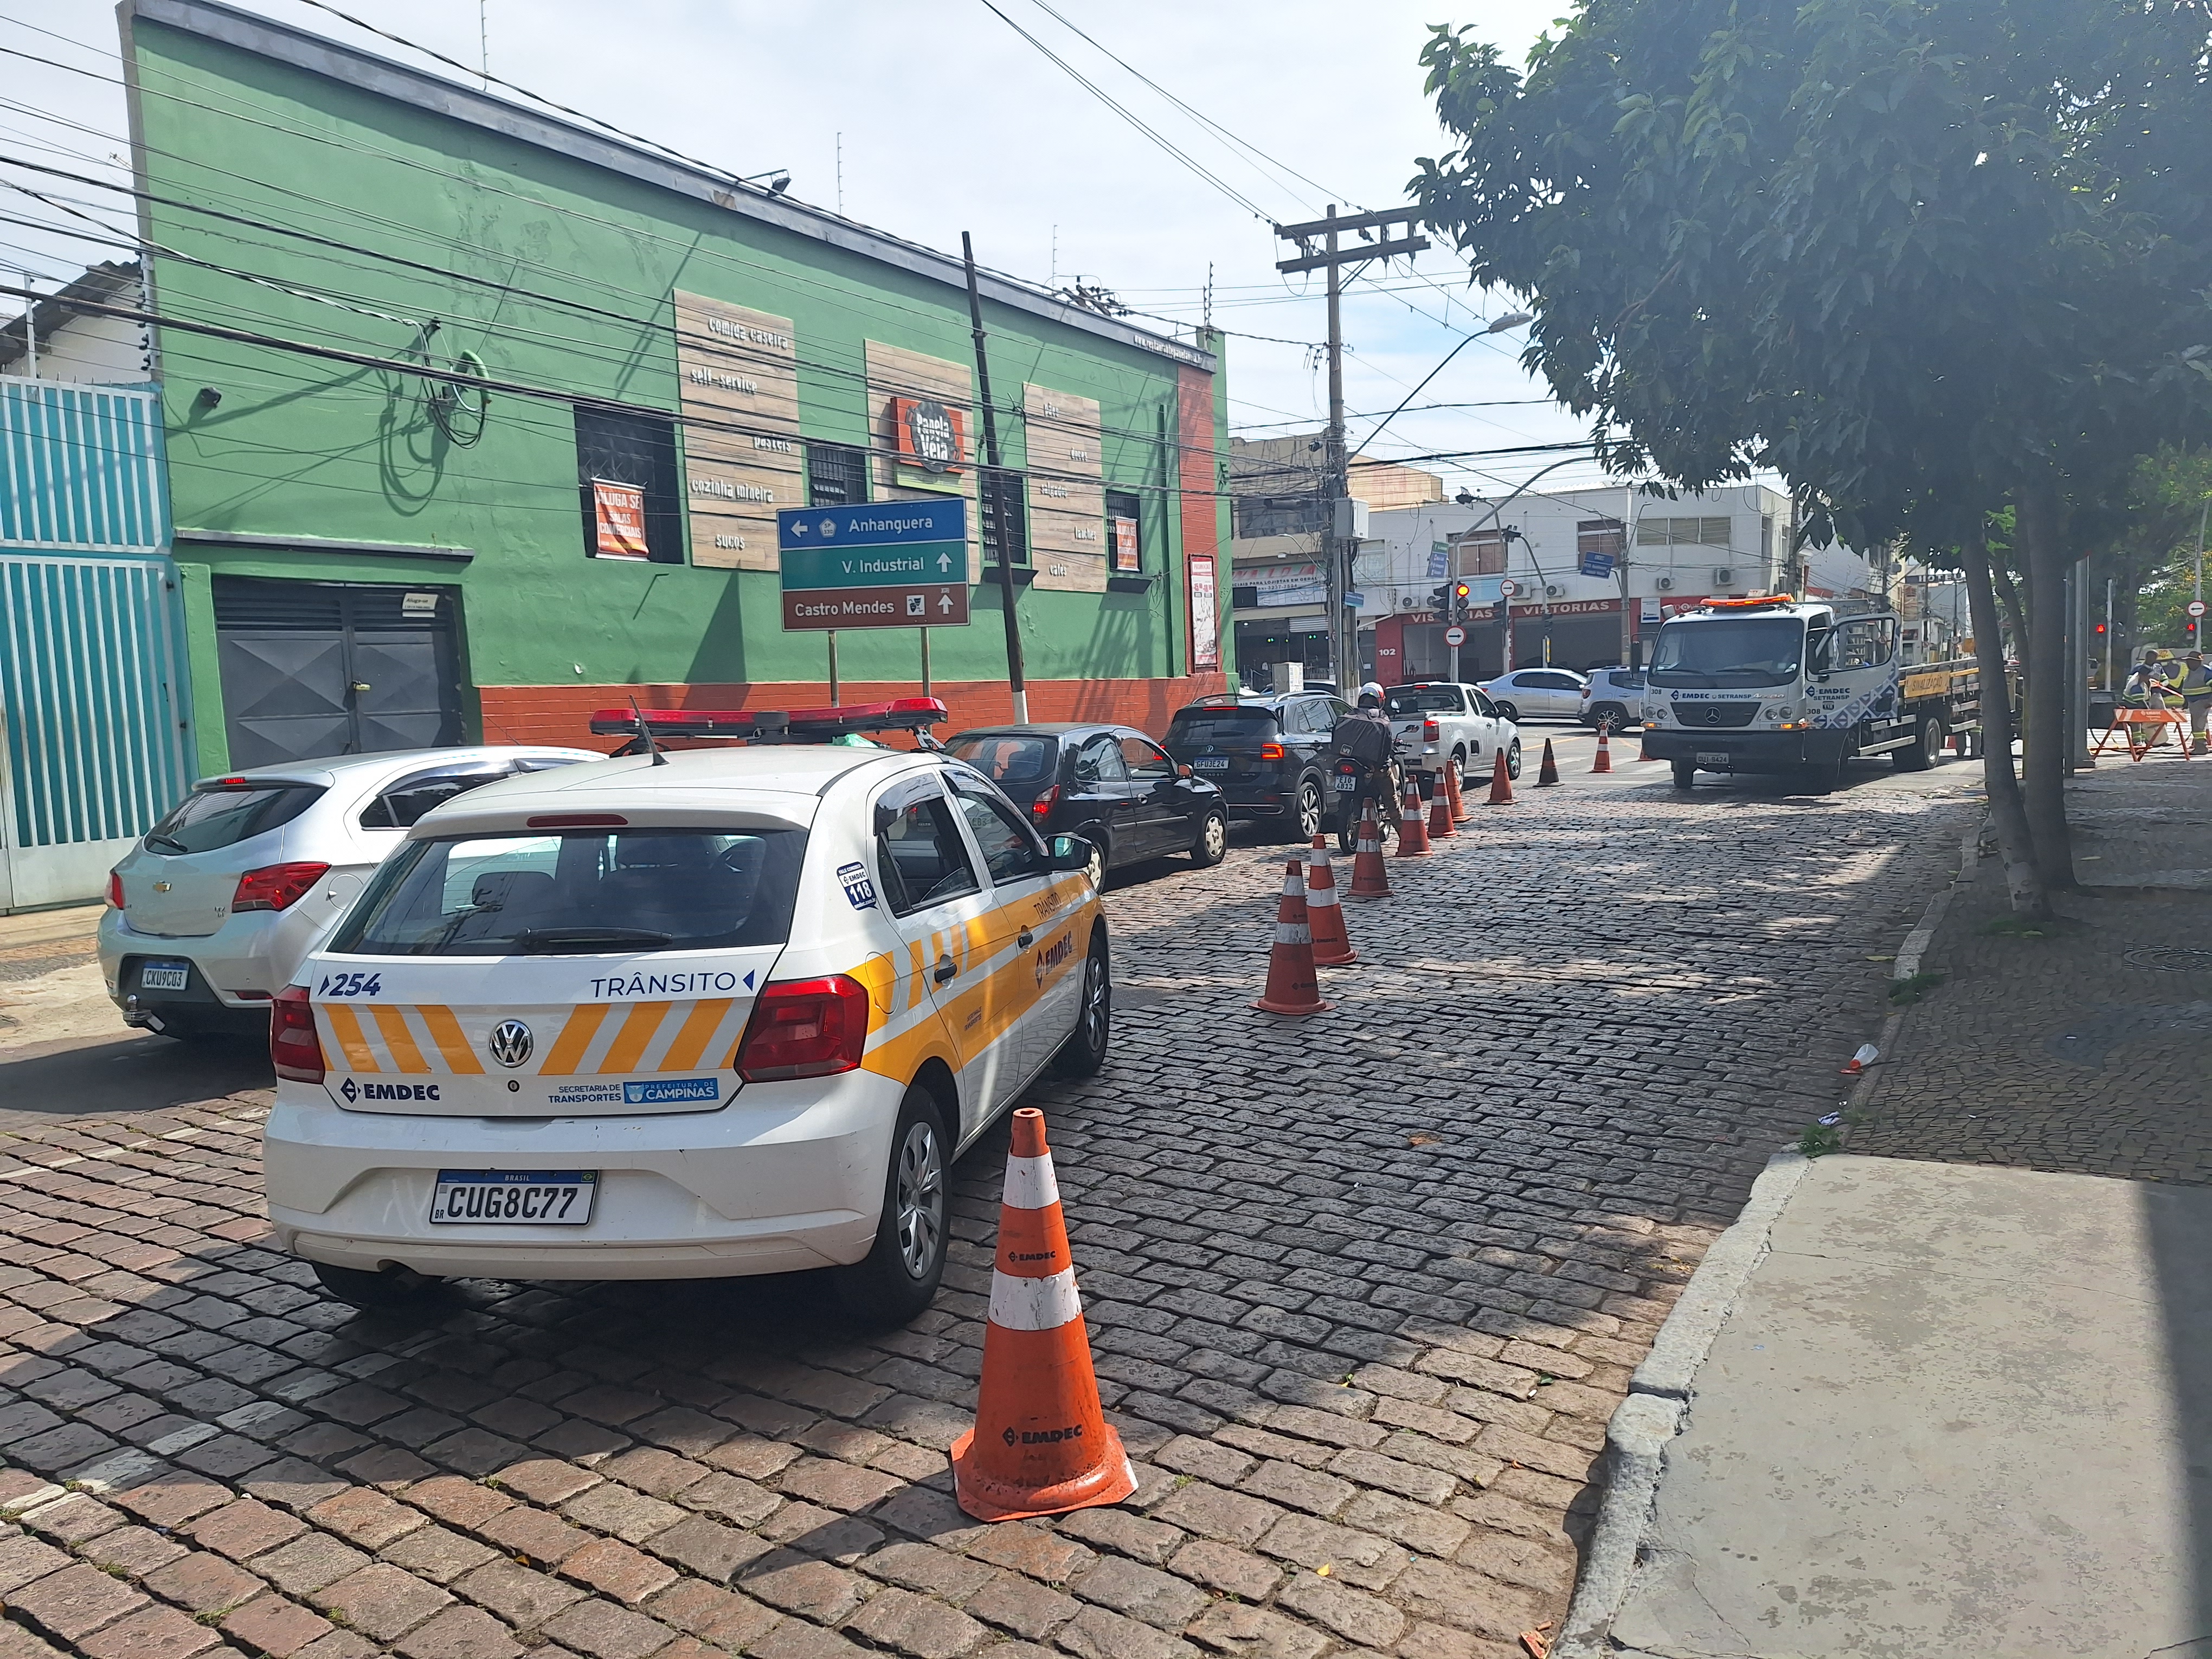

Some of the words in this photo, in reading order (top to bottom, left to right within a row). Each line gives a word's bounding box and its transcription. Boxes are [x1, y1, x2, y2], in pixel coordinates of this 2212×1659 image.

[709, 318, 748, 340] comida
[750, 329, 788, 349] caseira
[691, 367, 757, 394] self-service
[916, 414, 950, 438] Panela
[691, 477, 733, 497] cozinha
[736, 483, 773, 503] mineira
[1040, 481, 1068, 498] salgados
[597, 490, 628, 508] ALUGA
[629, 494, 640, 510] SE
[609, 511, 631, 524] SALAS
[848, 517, 933, 535] Anhanguera
[600, 522, 641, 538] COMERCIAIS
[1074, 526, 1096, 541] lanches
[716, 534, 745, 550] sucos
[841, 561, 857, 574] V.
[860, 557, 924, 573] Industrial
[1049, 563, 1067, 577] cafés
[795, 602, 839, 617] Castro
[842, 600, 895, 615] Mendes
[1523, 601, 1610, 615] VISTORIAS
[848, 871, 865, 882] EMDEC
[850, 881, 872, 902] 118
[1033, 892, 1062, 920] TRÂNSITO
[1045, 930, 1072, 975] EMDEC
[146, 970, 183, 987] CKU9C03
[329, 973, 382, 996] 254
[591, 972, 736, 998] TRÂNSITO
[364, 1084, 440, 1100] EMDEC
[559, 1084, 608, 1093] SECRETARIA
[646, 1086, 715, 1099] CAMPINAS
[549, 1093, 621, 1103] TRANSPORTES
[448, 1187, 578, 1219] CUG8C77
[435, 1210, 444, 1219] BR
[1019, 1251, 1056, 1261] EMDEC
[1022, 1424, 1082, 1444] EMDEC
